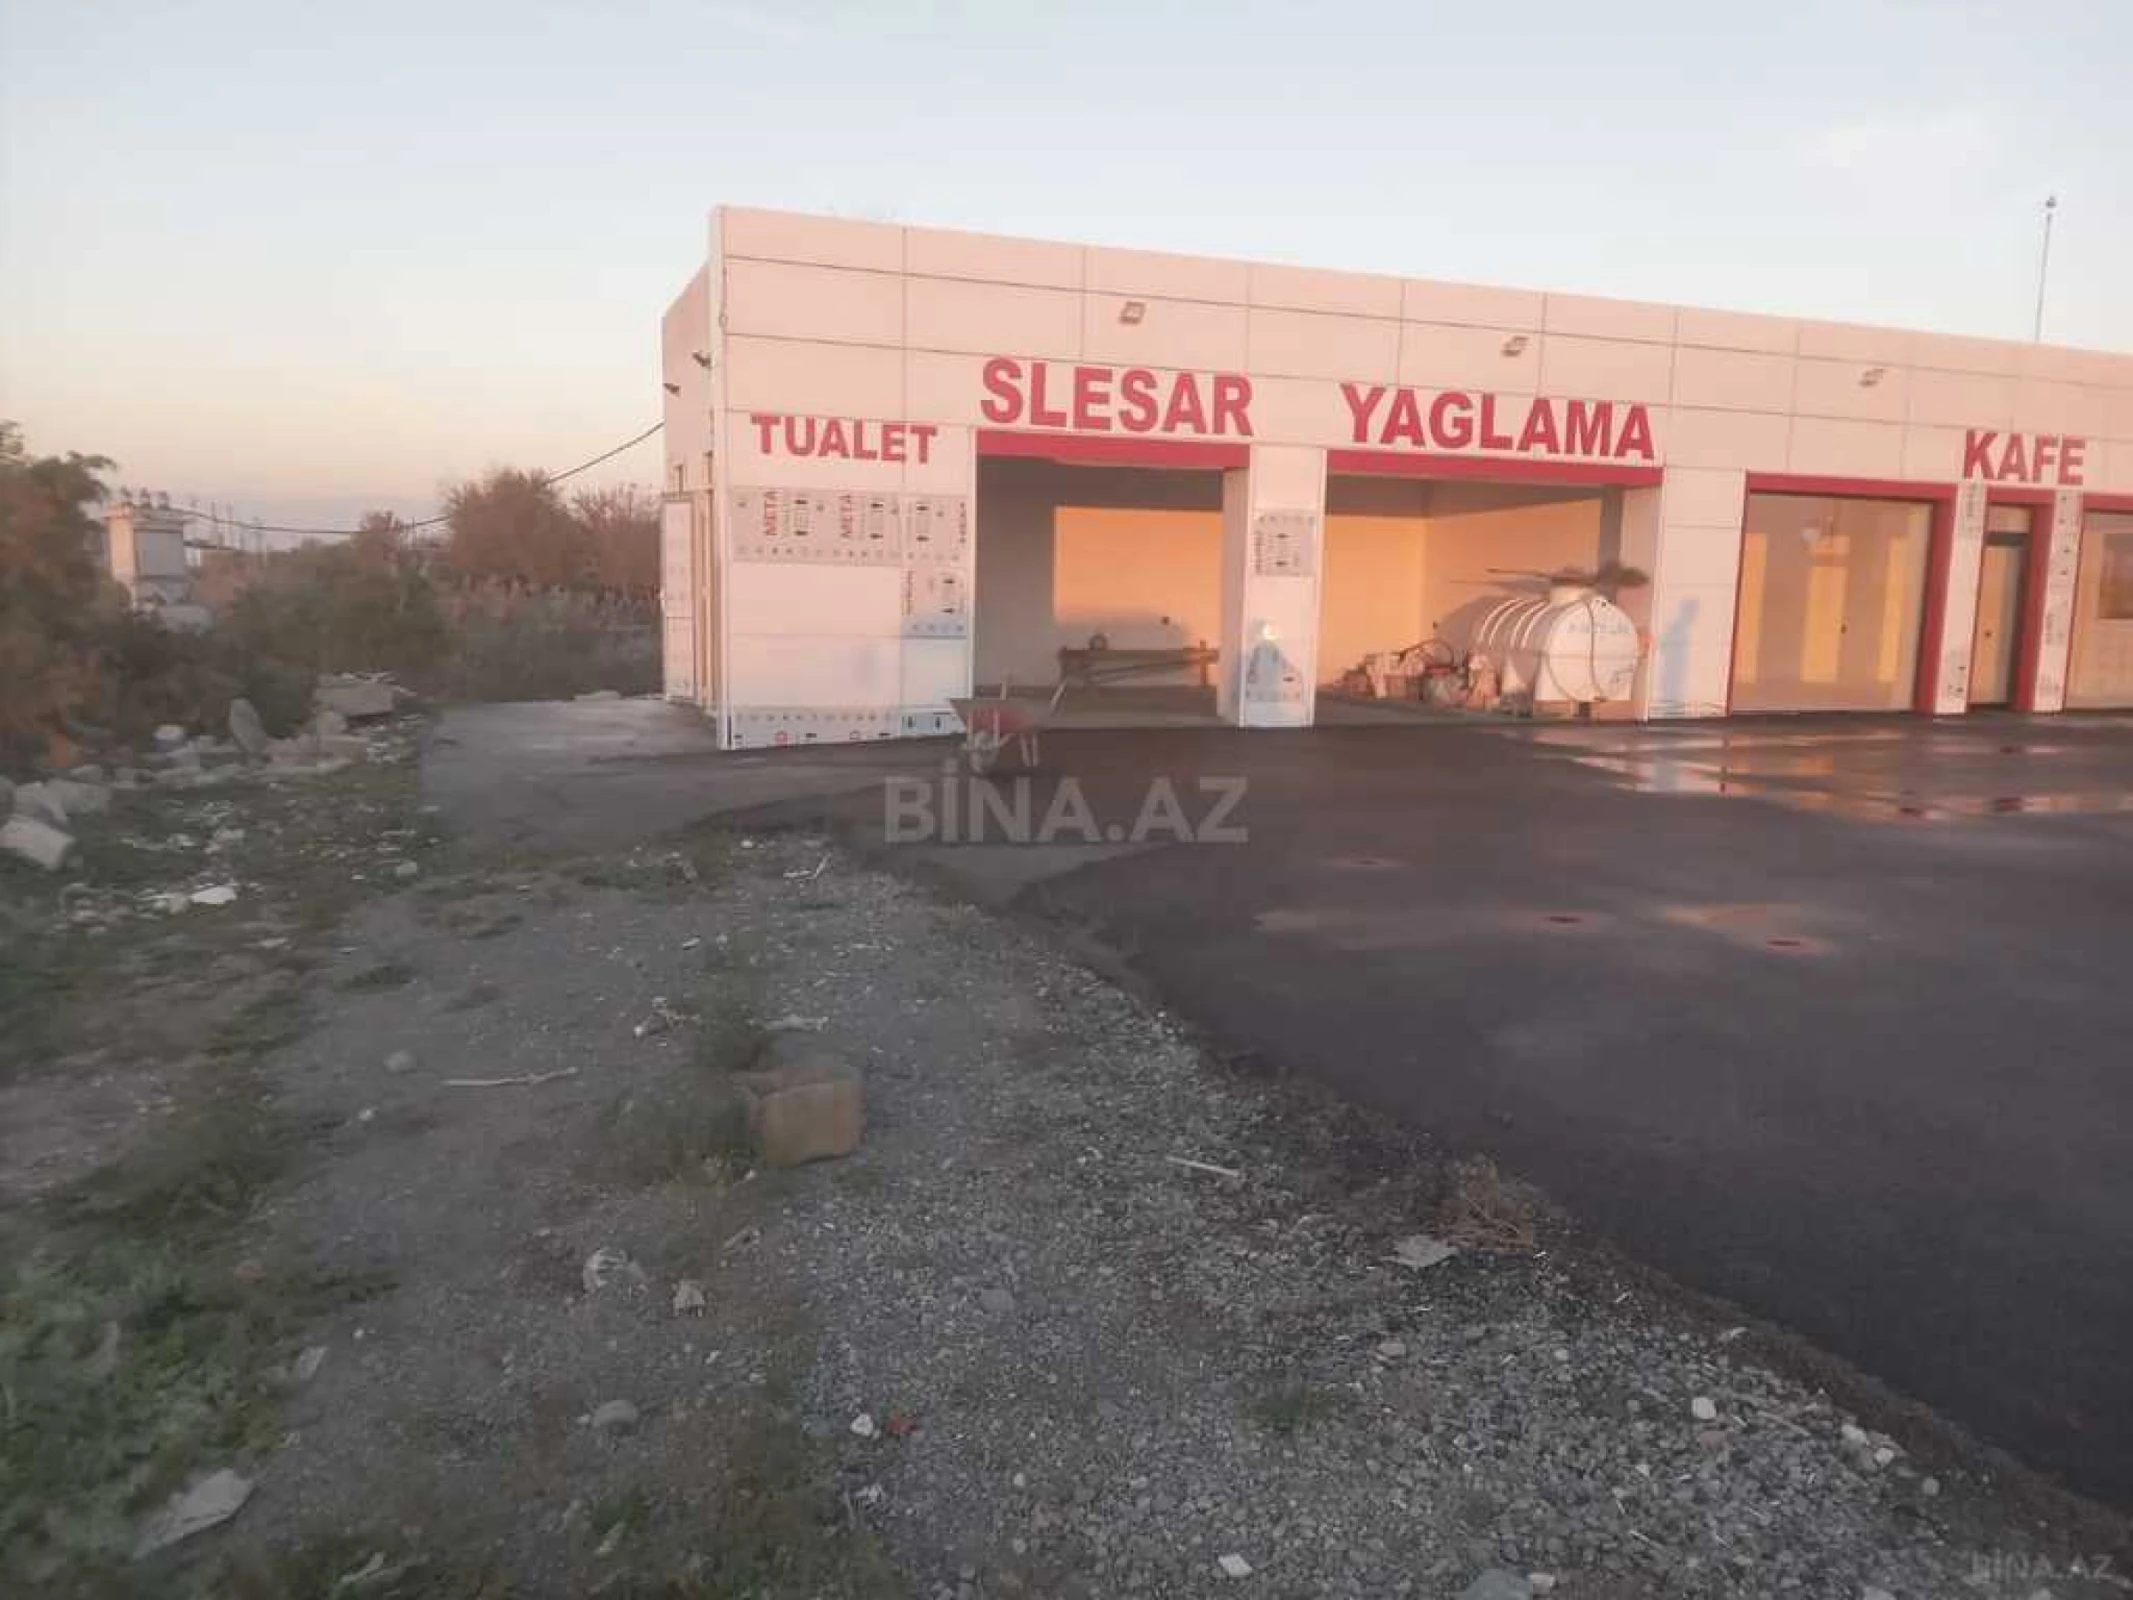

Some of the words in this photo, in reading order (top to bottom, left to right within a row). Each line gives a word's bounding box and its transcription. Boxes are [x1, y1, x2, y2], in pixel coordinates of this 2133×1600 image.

[981, 357, 1253, 437] SLESAR
[1340, 382, 1654, 459] YAGLAMA
[751, 413, 938, 464] TUALET
[1963, 429, 2086, 486] KAFE
